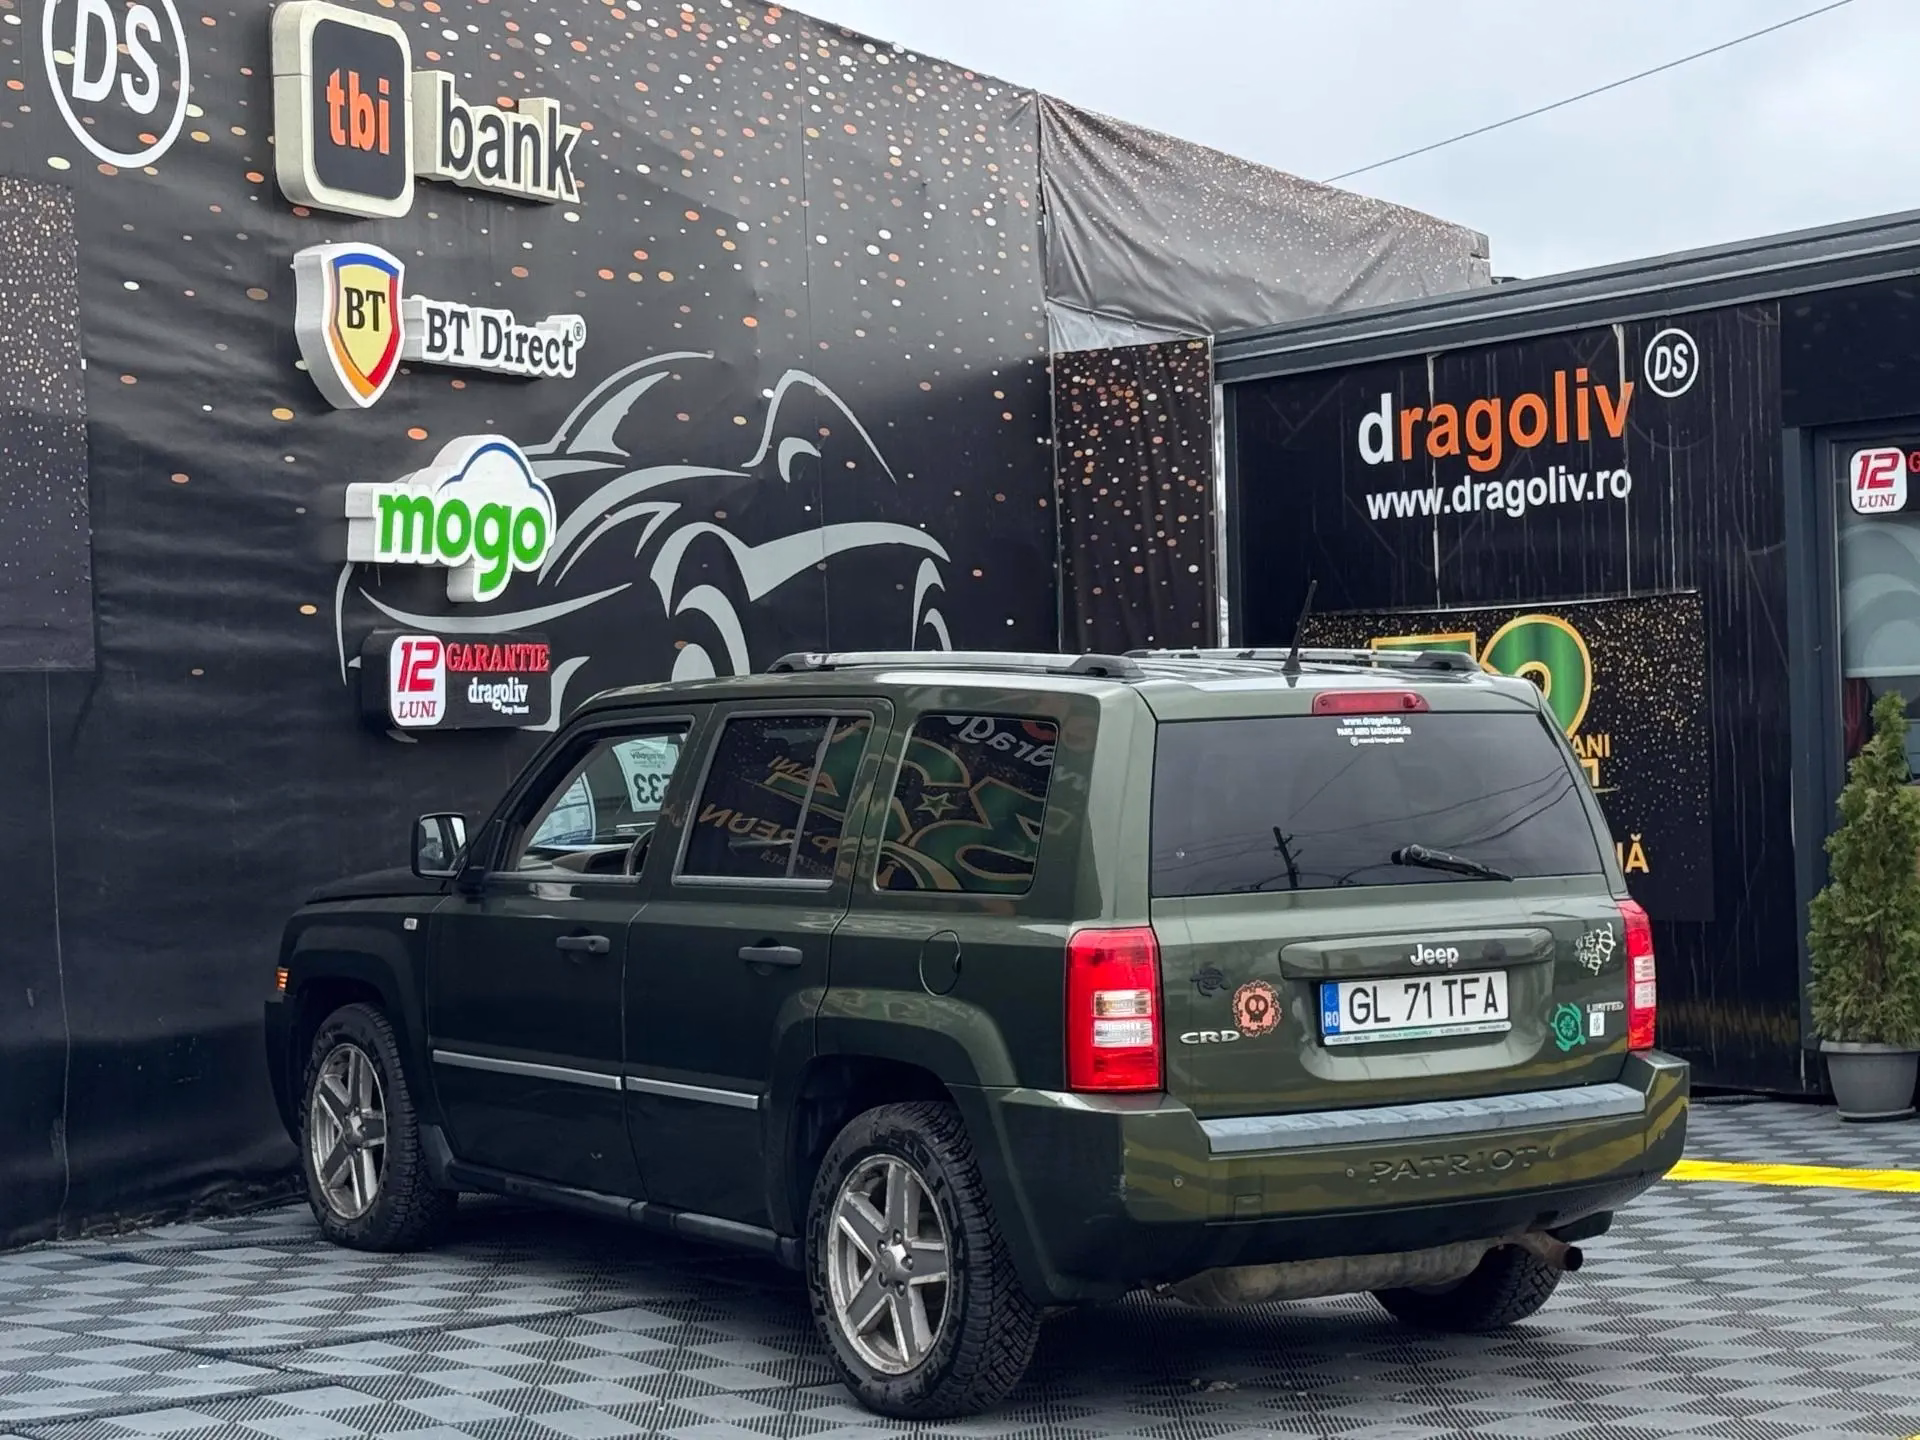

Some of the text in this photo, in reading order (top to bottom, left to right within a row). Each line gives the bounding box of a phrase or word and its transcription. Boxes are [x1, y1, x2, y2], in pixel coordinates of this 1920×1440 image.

[73, 0, 161, 114] DS
[327, 67, 577, 195] tbi bank
[344, 286, 385, 331] BT
[427, 307, 469, 355] BT
[1654, 342, 1688, 382] DS
[1357, 367, 1635, 473] dragoliv
[1857, 452, 1899, 490] 12
[1366, 466, 1632, 520] www.dragoliv.ro
[1858, 493, 1896, 508] LUNI
[378, 493, 546, 593] mogo
[397, 641, 440, 693] 12
[446, 642, 549, 672] GARANTIE
[398, 700, 437, 719] LUNI
[468, 676, 529, 711] dragoliv
[1410, 943, 1459, 968] Jeep
[1325, 1011, 1339, 1028] RO
[1349, 976, 1498, 1025] GL 71 TFA
[1180, 1030, 1241, 1045] CRD
[1367, 1146, 1539, 1184] PATRIOT
